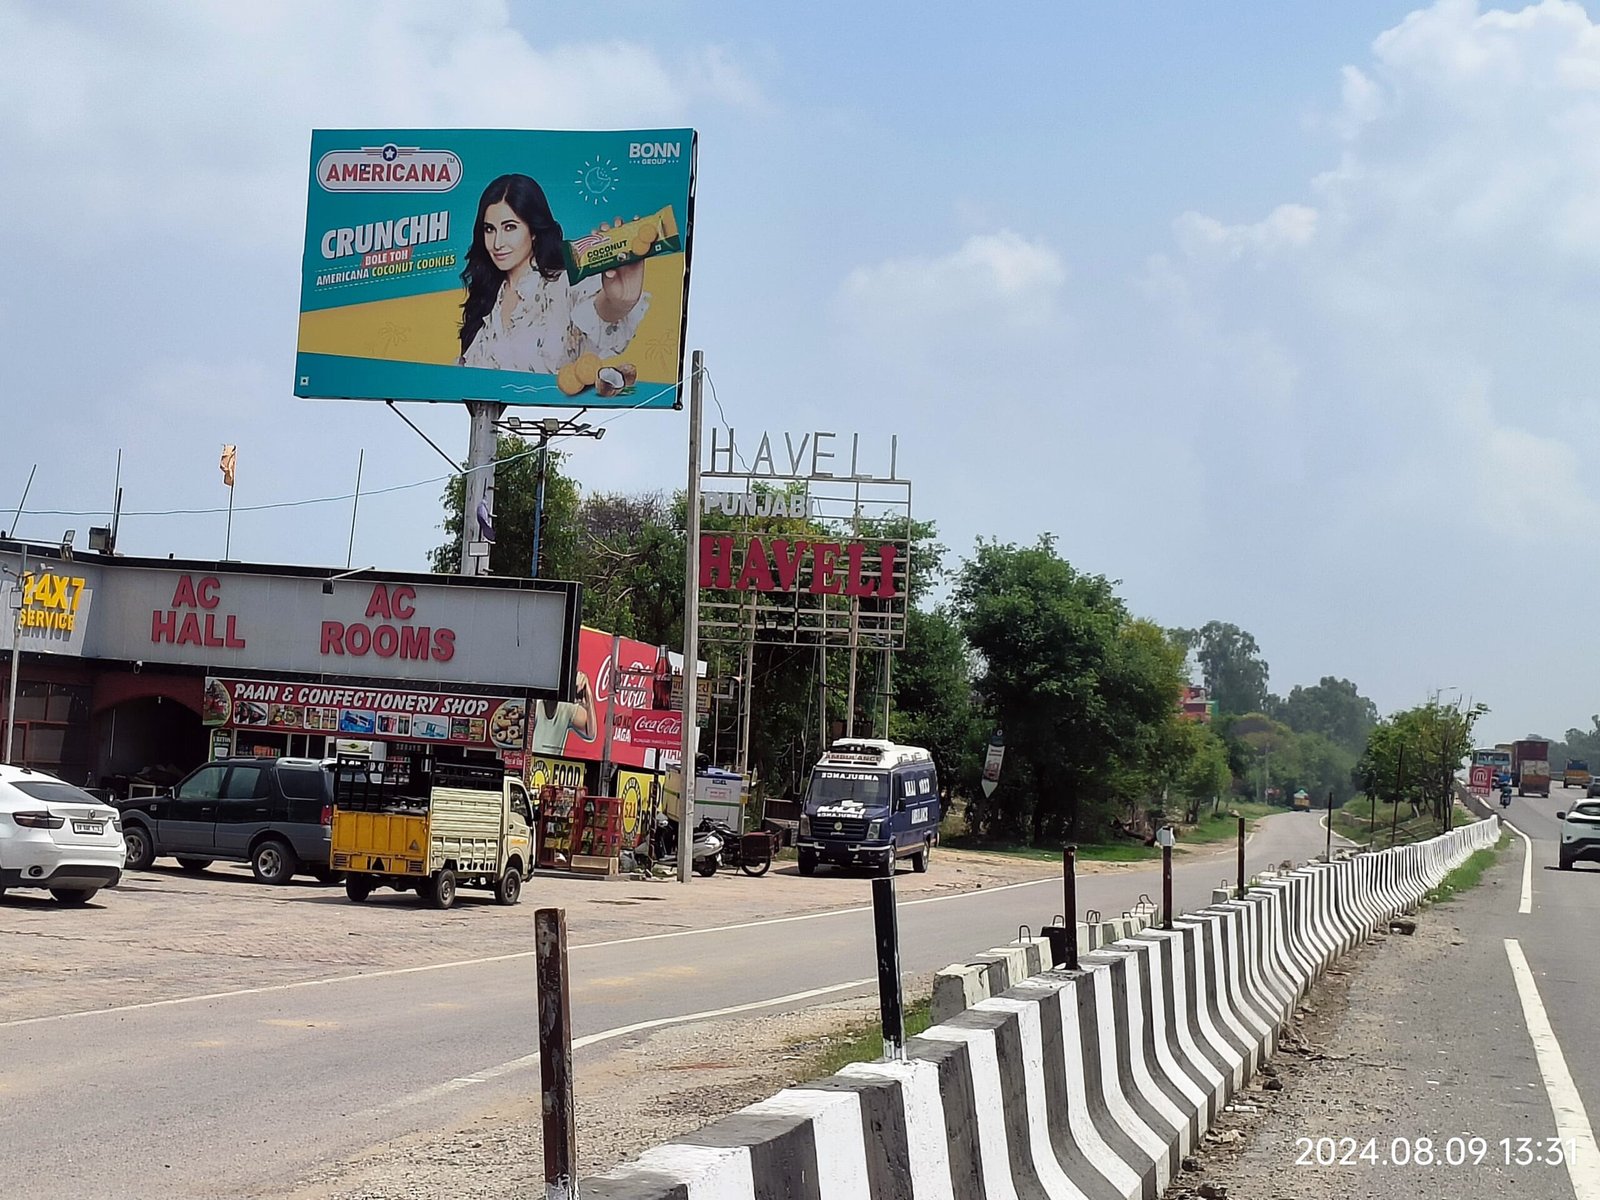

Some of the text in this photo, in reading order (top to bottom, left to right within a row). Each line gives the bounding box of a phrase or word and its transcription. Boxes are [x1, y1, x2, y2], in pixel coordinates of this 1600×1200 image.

[629, 142, 681, 158] BONN
[325, 163, 452, 182] AMERICANA
[320, 210, 450, 260] CRUNCHH
[587, 239, 628, 258] COCONUT
[315, 254, 456, 287] AMERICANA COCONUT COOKIES
[365, 249, 409, 266] BOLE TOH
[703, 491, 815, 518] PUNJABI
[699, 534, 898, 599] HAVELI
[171, 574, 221, 609] AC
[364, 583, 416, 620] AC
[20, 607, 76, 632] SERVICE
[151, 610, 246, 649] HALL
[320, 621, 457, 662] ROOMS
[233, 682, 490, 717] PAAN & CONFECTIONERY SHOP
[552, 763, 581, 787] FOOD
